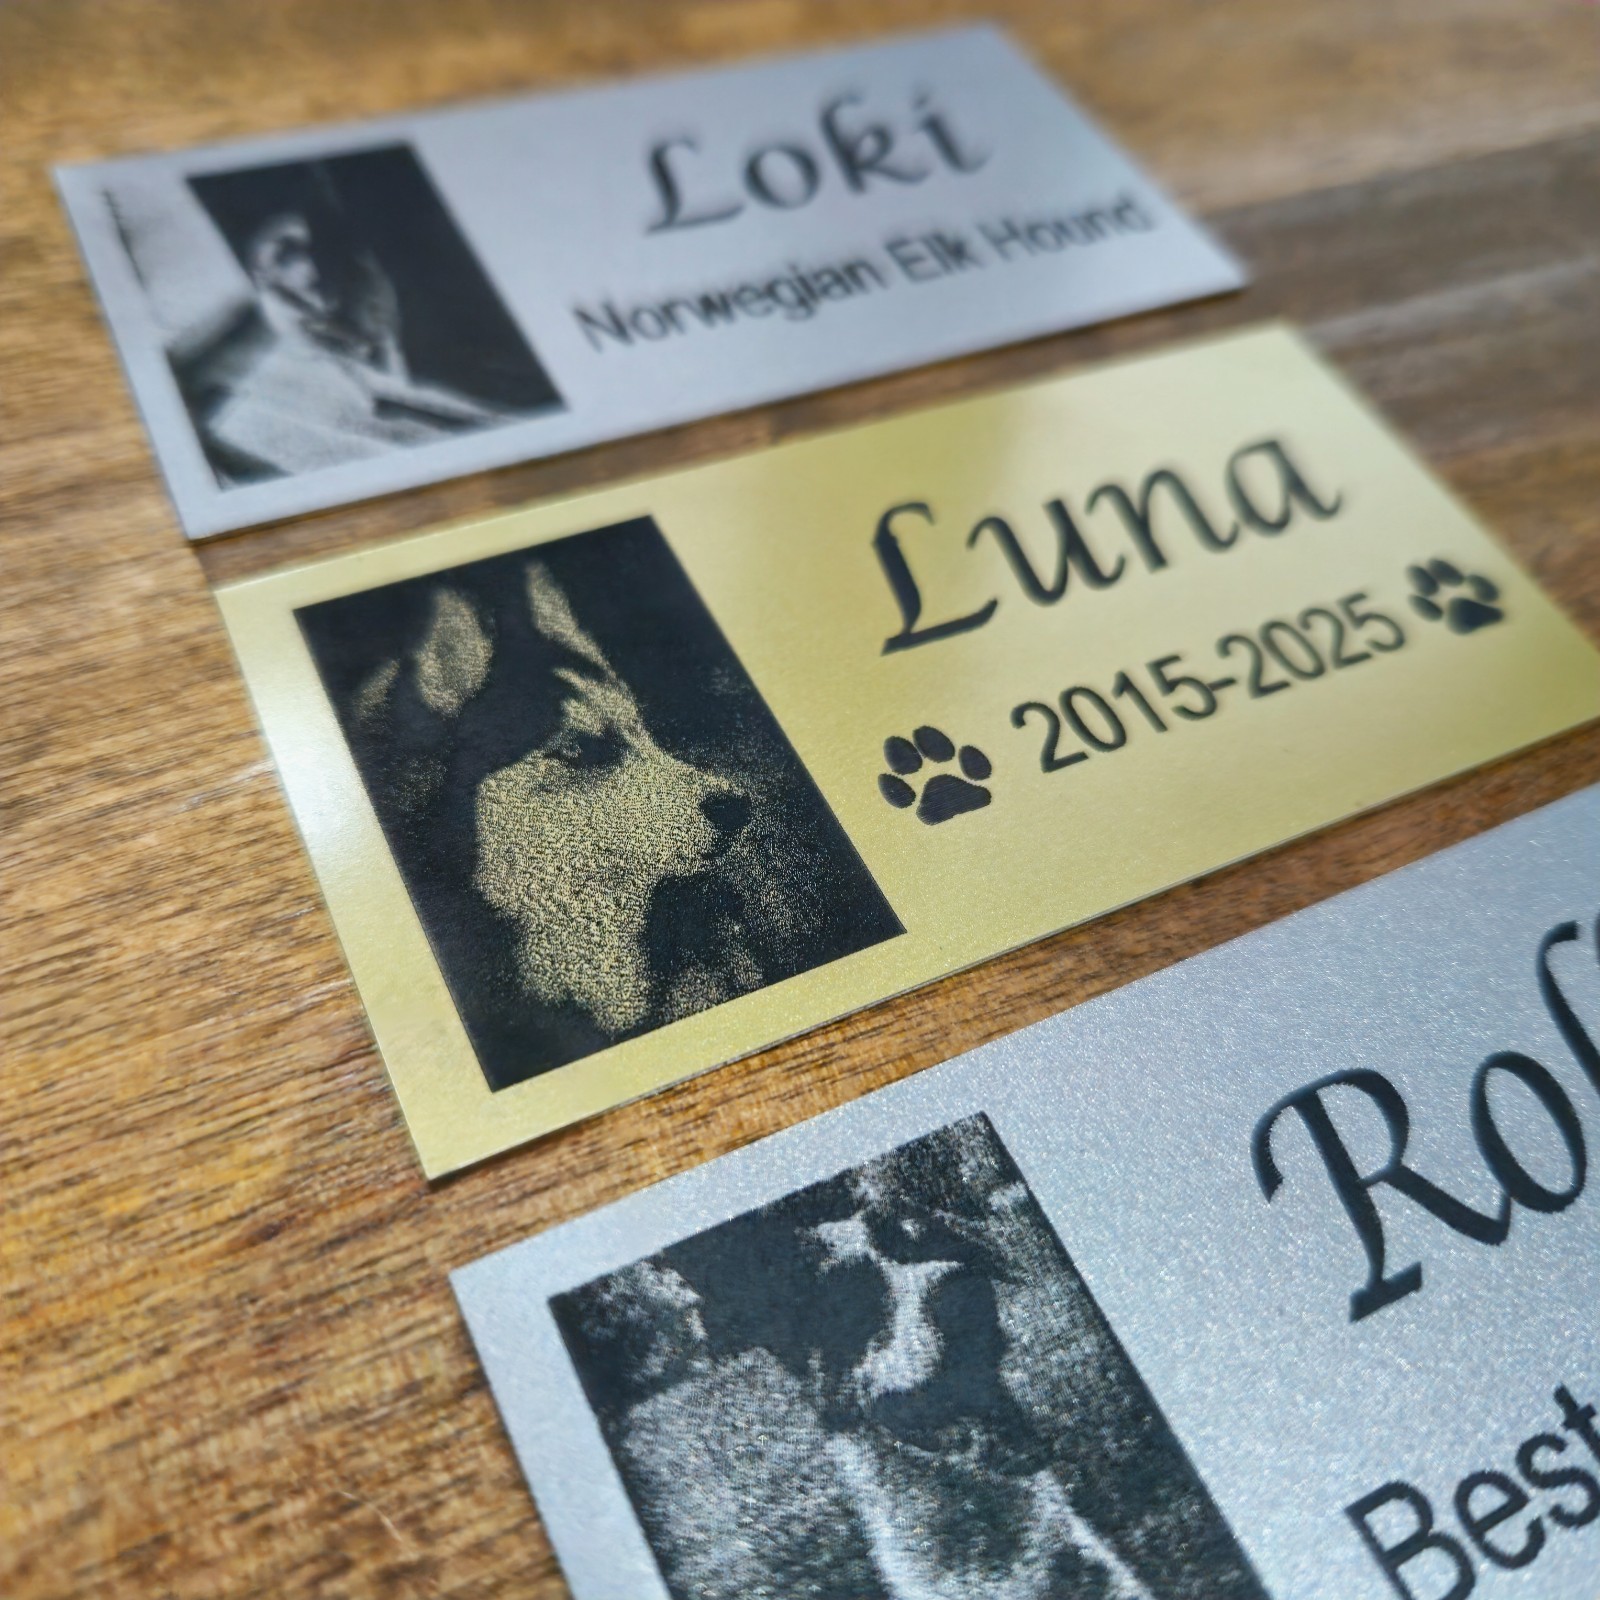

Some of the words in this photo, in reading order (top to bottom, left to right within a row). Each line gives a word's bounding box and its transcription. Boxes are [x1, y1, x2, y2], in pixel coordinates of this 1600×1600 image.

[644, 88, 991, 235] Loki
[573, 256, 885, 352] Norwegian
[886, 226, 978, 281] Elk
[978, 191, 1155, 264] Hound
[871, 438, 1343, 655] Luna
[1010, 590, 1406, 773] 2015-2025
